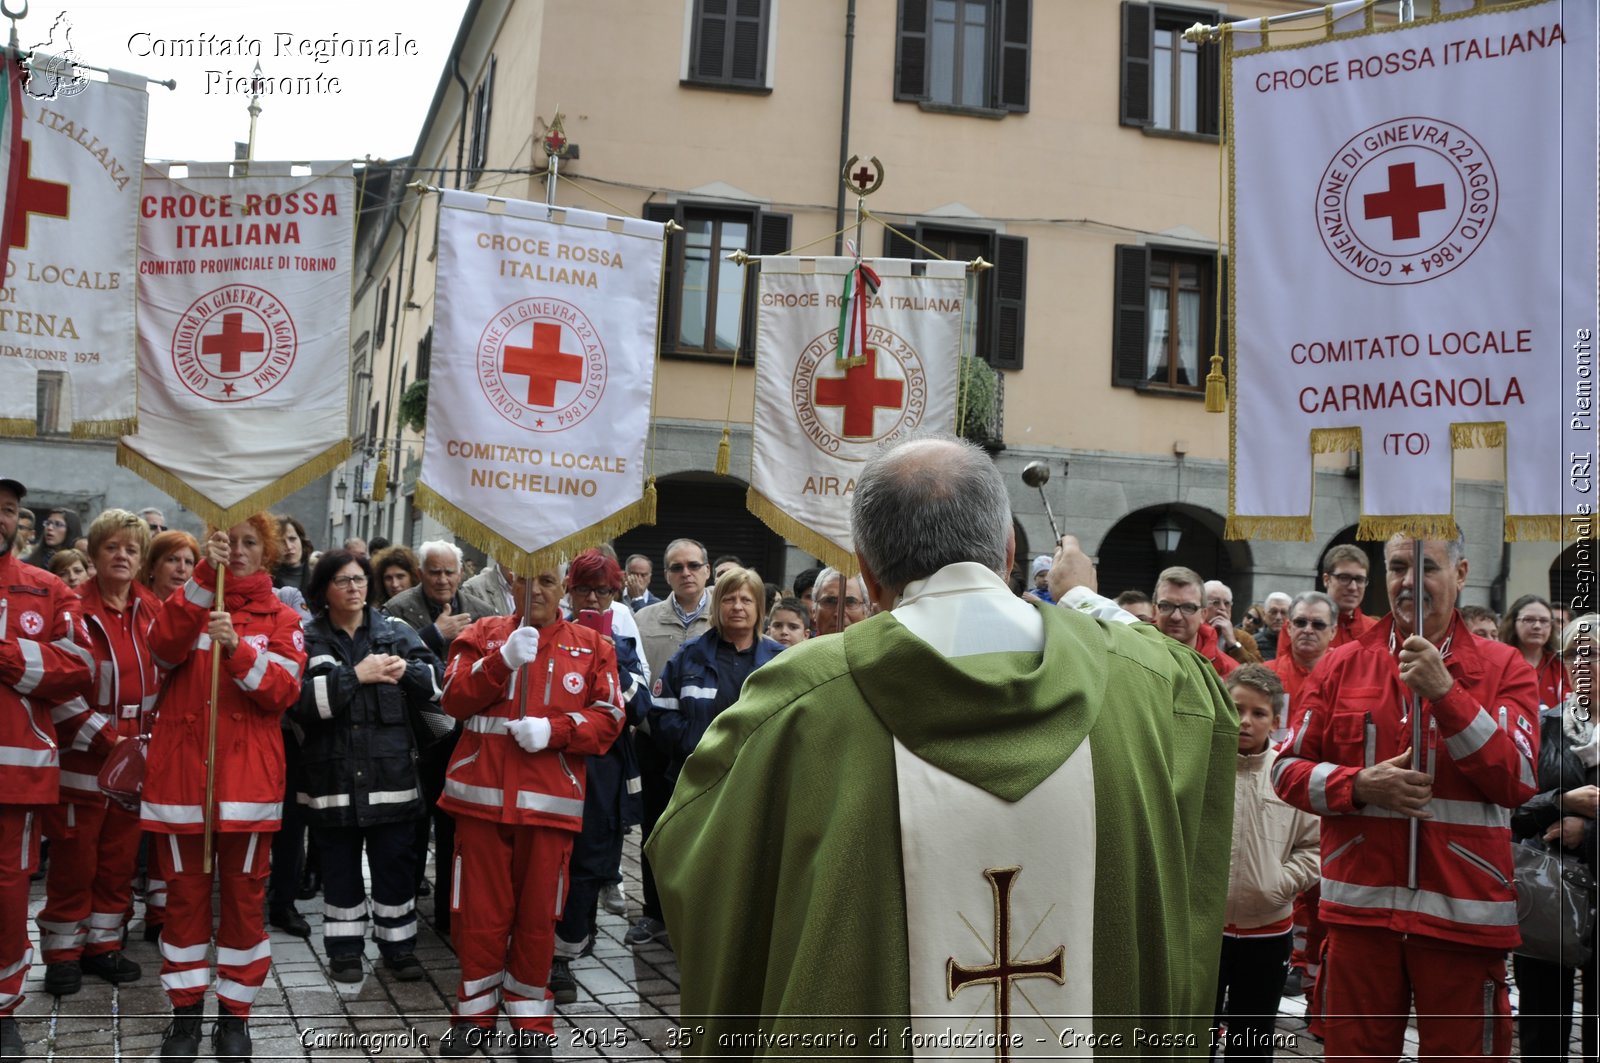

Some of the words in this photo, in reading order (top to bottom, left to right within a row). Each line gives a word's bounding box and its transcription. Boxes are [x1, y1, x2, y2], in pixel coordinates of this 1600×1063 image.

[1255, 62, 1340, 93] CROCE
[1347, 47, 1436, 81] ROSSA
[1443, 23, 1567, 65] ITALIANA
[37, 107, 130, 191] ITALIANA
[1364, 124, 1449, 151] GINEVRA
[1341, 147, 1363, 168] DI
[1448, 140, 1473, 163] 22
[141, 195, 234, 219] CROCE
[246, 192, 337, 217] ROSSA
[1461, 162, 1490, 240] AGOSTO
[176, 221, 301, 248] ITALIANA
[1323, 169, 1392, 276] CONVENZIONE
[476, 233, 550, 257] CROCE
[556, 244, 624, 269] ROSSA
[1420, 242, 1462, 272] 1864
[27, 262, 120, 290] LOCALE
[140, 259, 196, 275] COMITATO
[200, 258, 274, 274] PROVINCIALE
[278, 258, 290, 271] DI
[295, 256, 336, 271] TORINO
[500, 261, 598, 289] ITALIANA
[196, 302, 212, 318] DI
[213, 289, 264, 309] GINEVRA
[262, 303, 280, 319] 22
[762, 293, 820, 308] CROCE
[890, 296, 961, 312] ITALIANA
[0, 309, 80, 340] TENA
[499, 312, 515, 328] DI
[518, 302, 577, 324] GINEVRA
[272, 320, 292, 365] AGOSTO
[577, 322, 592, 340] 22
[74, 352, 100, 363] 1974
[177, 316, 209, 391] CONVENZIONE
[809, 341, 826, 358] DI
[896, 344, 913, 363] 22
[1290, 334, 1419, 365] COMITATO
[1428, 329, 1532, 356] LOCALE
[253, 365, 281, 389] 1864
[482, 326, 522, 420] CONVENZIONE
[587, 344, 603, 400] AGOSTO
[796, 356, 840, 452] CONVENZIONE
[903, 368, 924, 428] AGOSTO
[1299, 377, 1525, 414] CARMAGNOLA
[557, 401, 588, 425] 1864
[447, 440, 543, 465] COMITATO
[551, 452, 627, 474] LOCALE
[1383, 432, 1430, 456] (TO)
[470, 468, 598, 497] NICHELINO
[801, 476, 856, 496] AIRA
